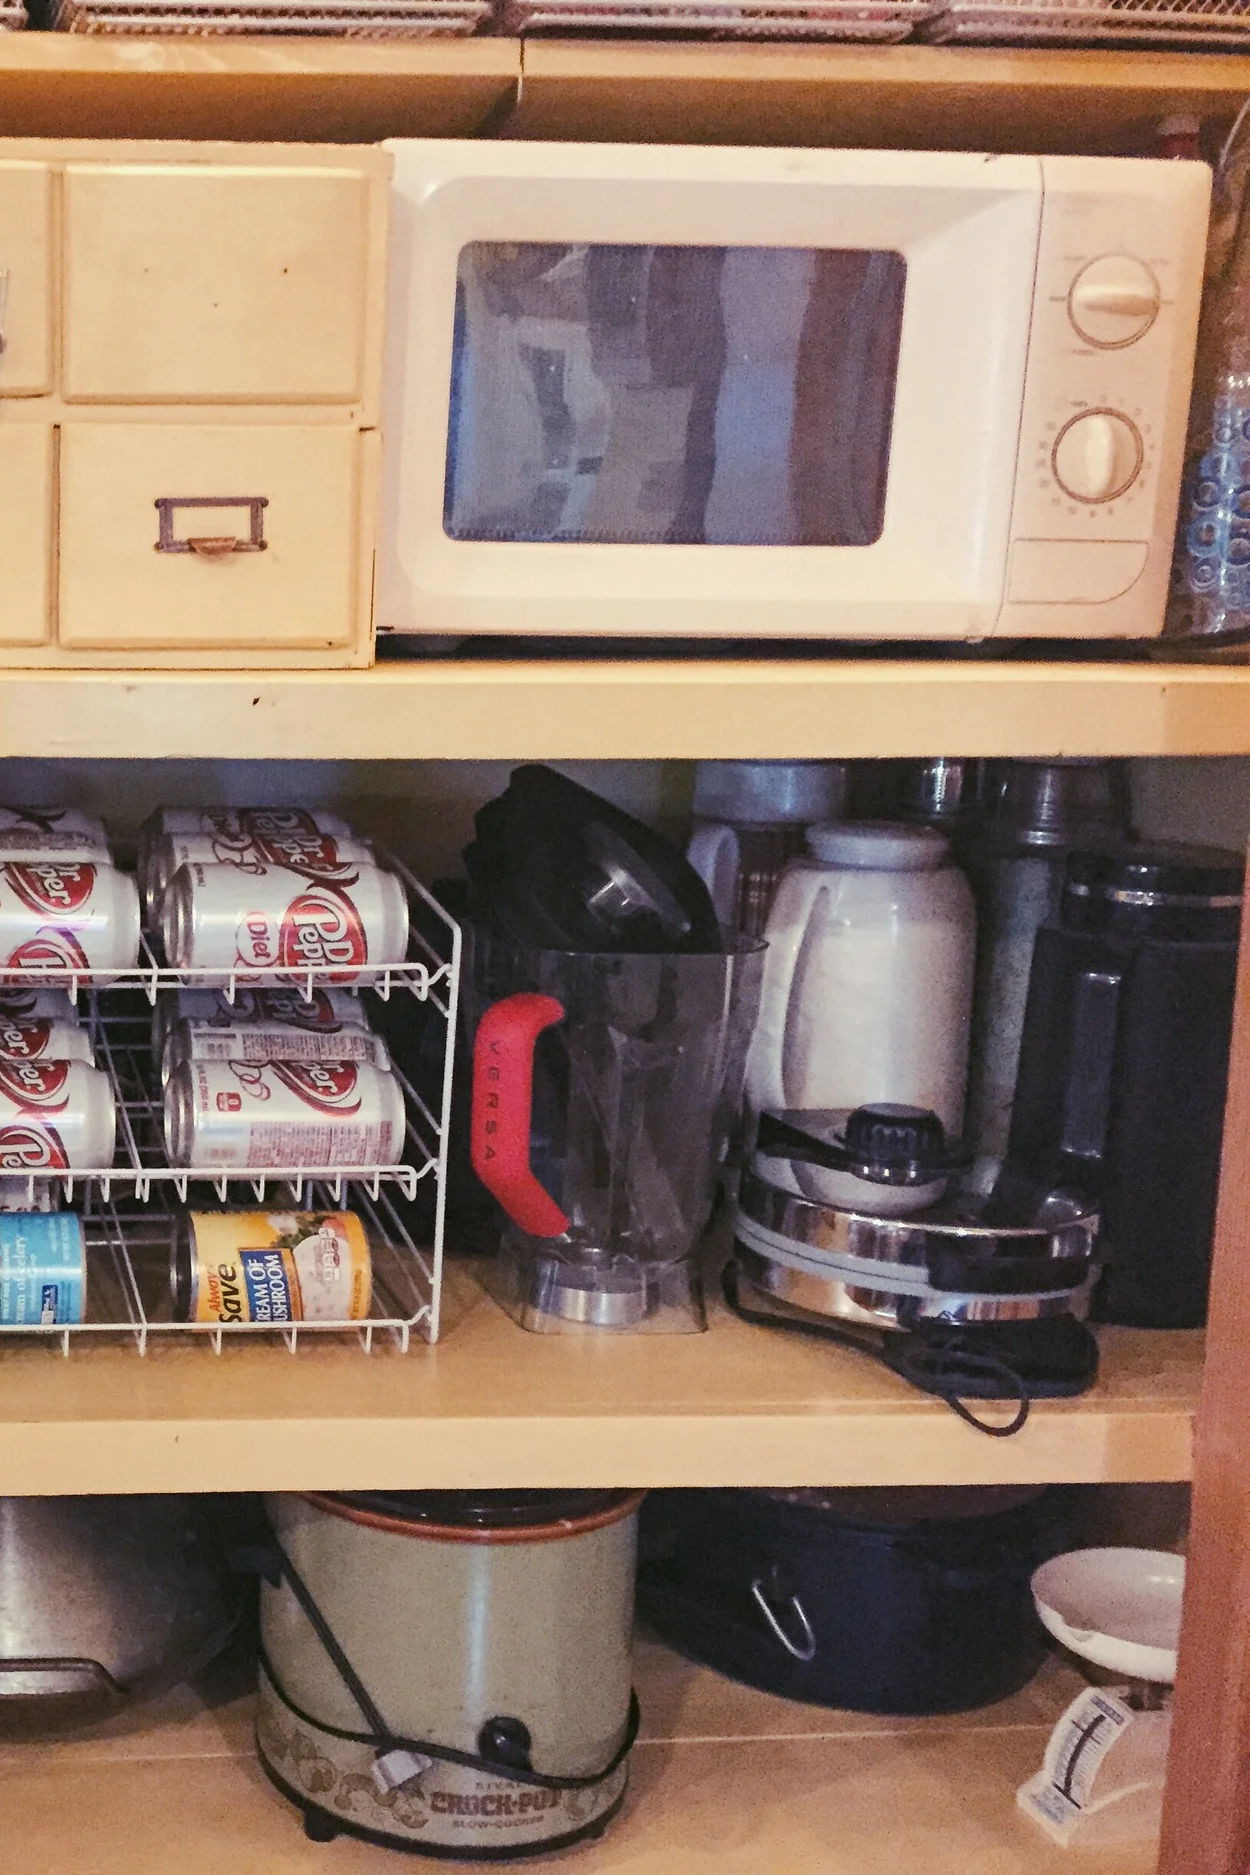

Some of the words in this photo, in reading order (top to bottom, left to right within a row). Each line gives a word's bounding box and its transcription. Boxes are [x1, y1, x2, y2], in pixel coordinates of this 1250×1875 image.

[247, 921, 271, 959] Diet
[484, 1040, 501, 1160] VERSA
[217, 1263, 243, 1323] Save
[247, 1258, 266, 1281] OF
[264, 1254, 288, 1322] USHROOM
